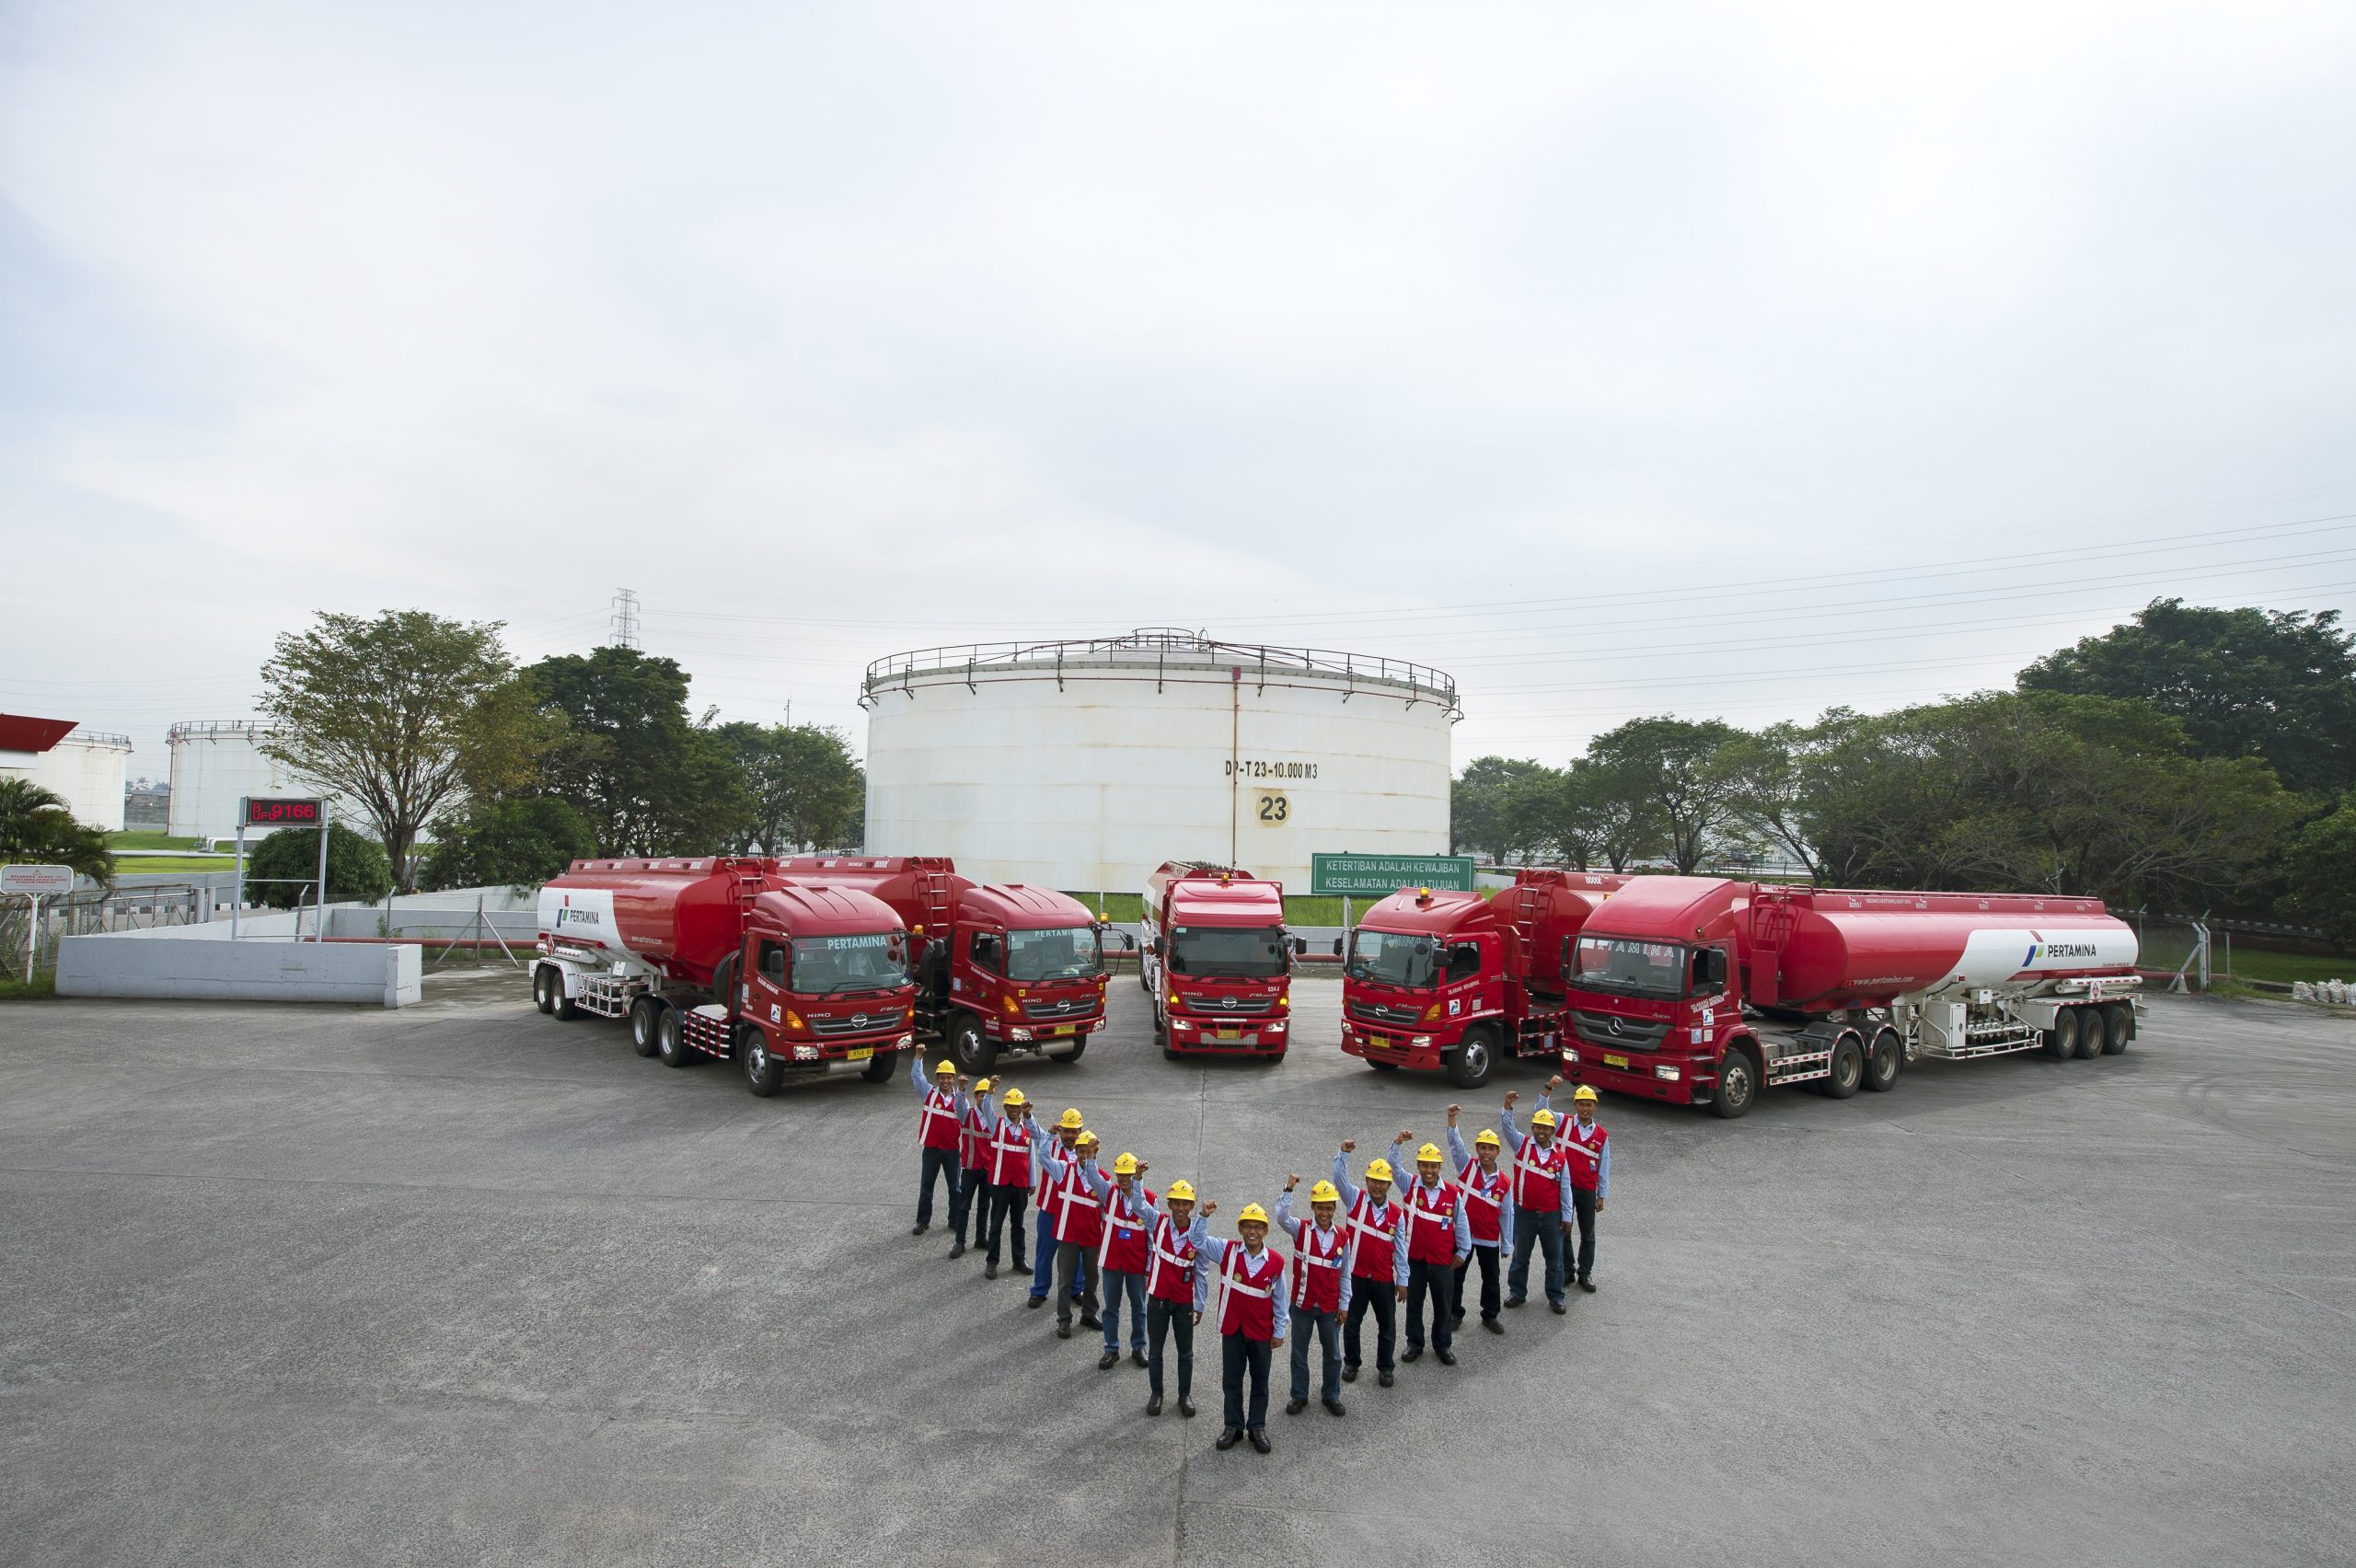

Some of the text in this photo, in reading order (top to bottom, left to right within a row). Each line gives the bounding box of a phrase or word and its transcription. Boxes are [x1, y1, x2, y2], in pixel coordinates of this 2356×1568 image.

[271, 804, 316, 819] 9166
[1260, 796, 1287, 821] 23
[1326, 860, 1460, 873] KETERTIBAN ADALAH KEWAJIBAN
[1325, 877, 1460, 890] KESELAMATAN ADALAH TUJUAN
[571, 910, 600, 925] PERTAMINA
[1034, 928, 1074, 938] PERTAMI
[827, 936, 887, 951] PERTAMINA
[1598, 940, 1674, 958] TAMINA
[2047, 944, 2096, 958] PERTAMINA
